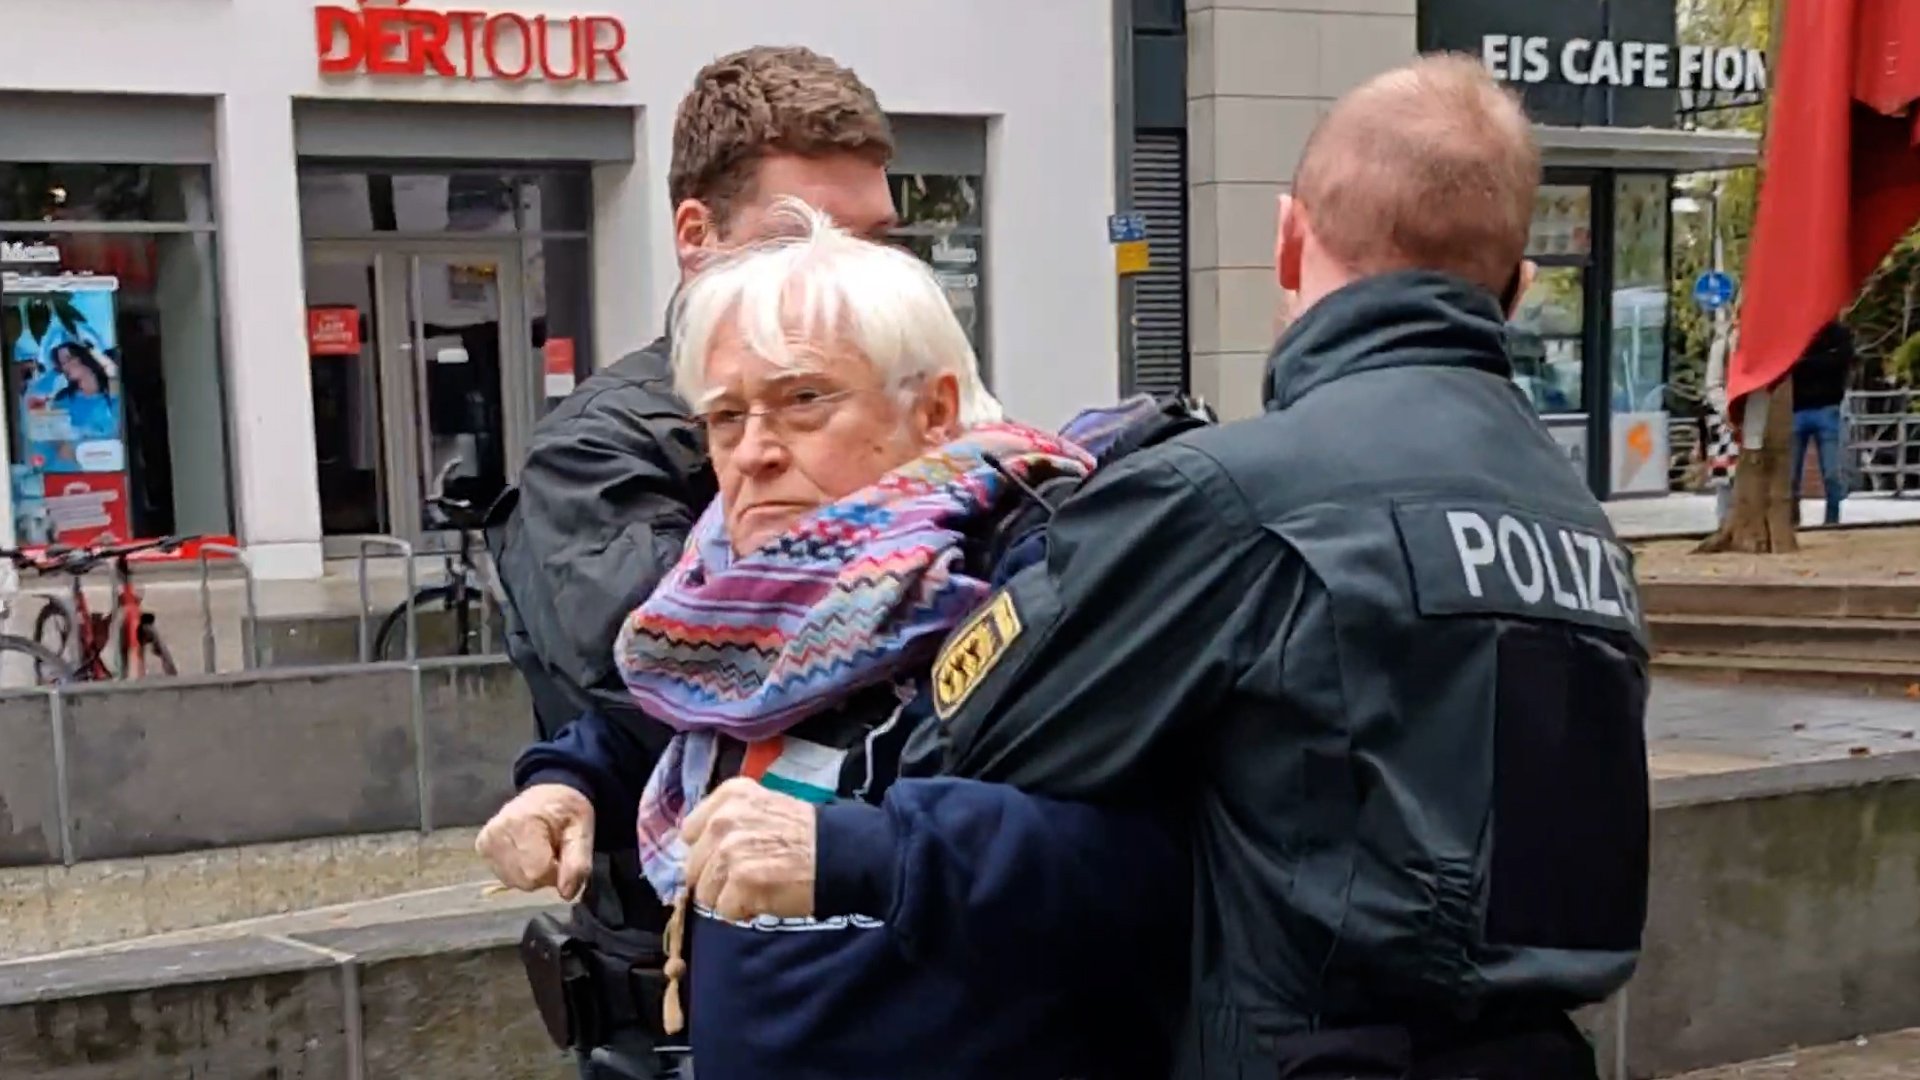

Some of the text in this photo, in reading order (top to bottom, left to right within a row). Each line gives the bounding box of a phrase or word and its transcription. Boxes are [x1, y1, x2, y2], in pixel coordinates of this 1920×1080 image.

[315, 5, 629, 82] DERTOUR
[1482, 34, 1549, 83] EIS
[1560, 38, 1669, 87] CAFE
